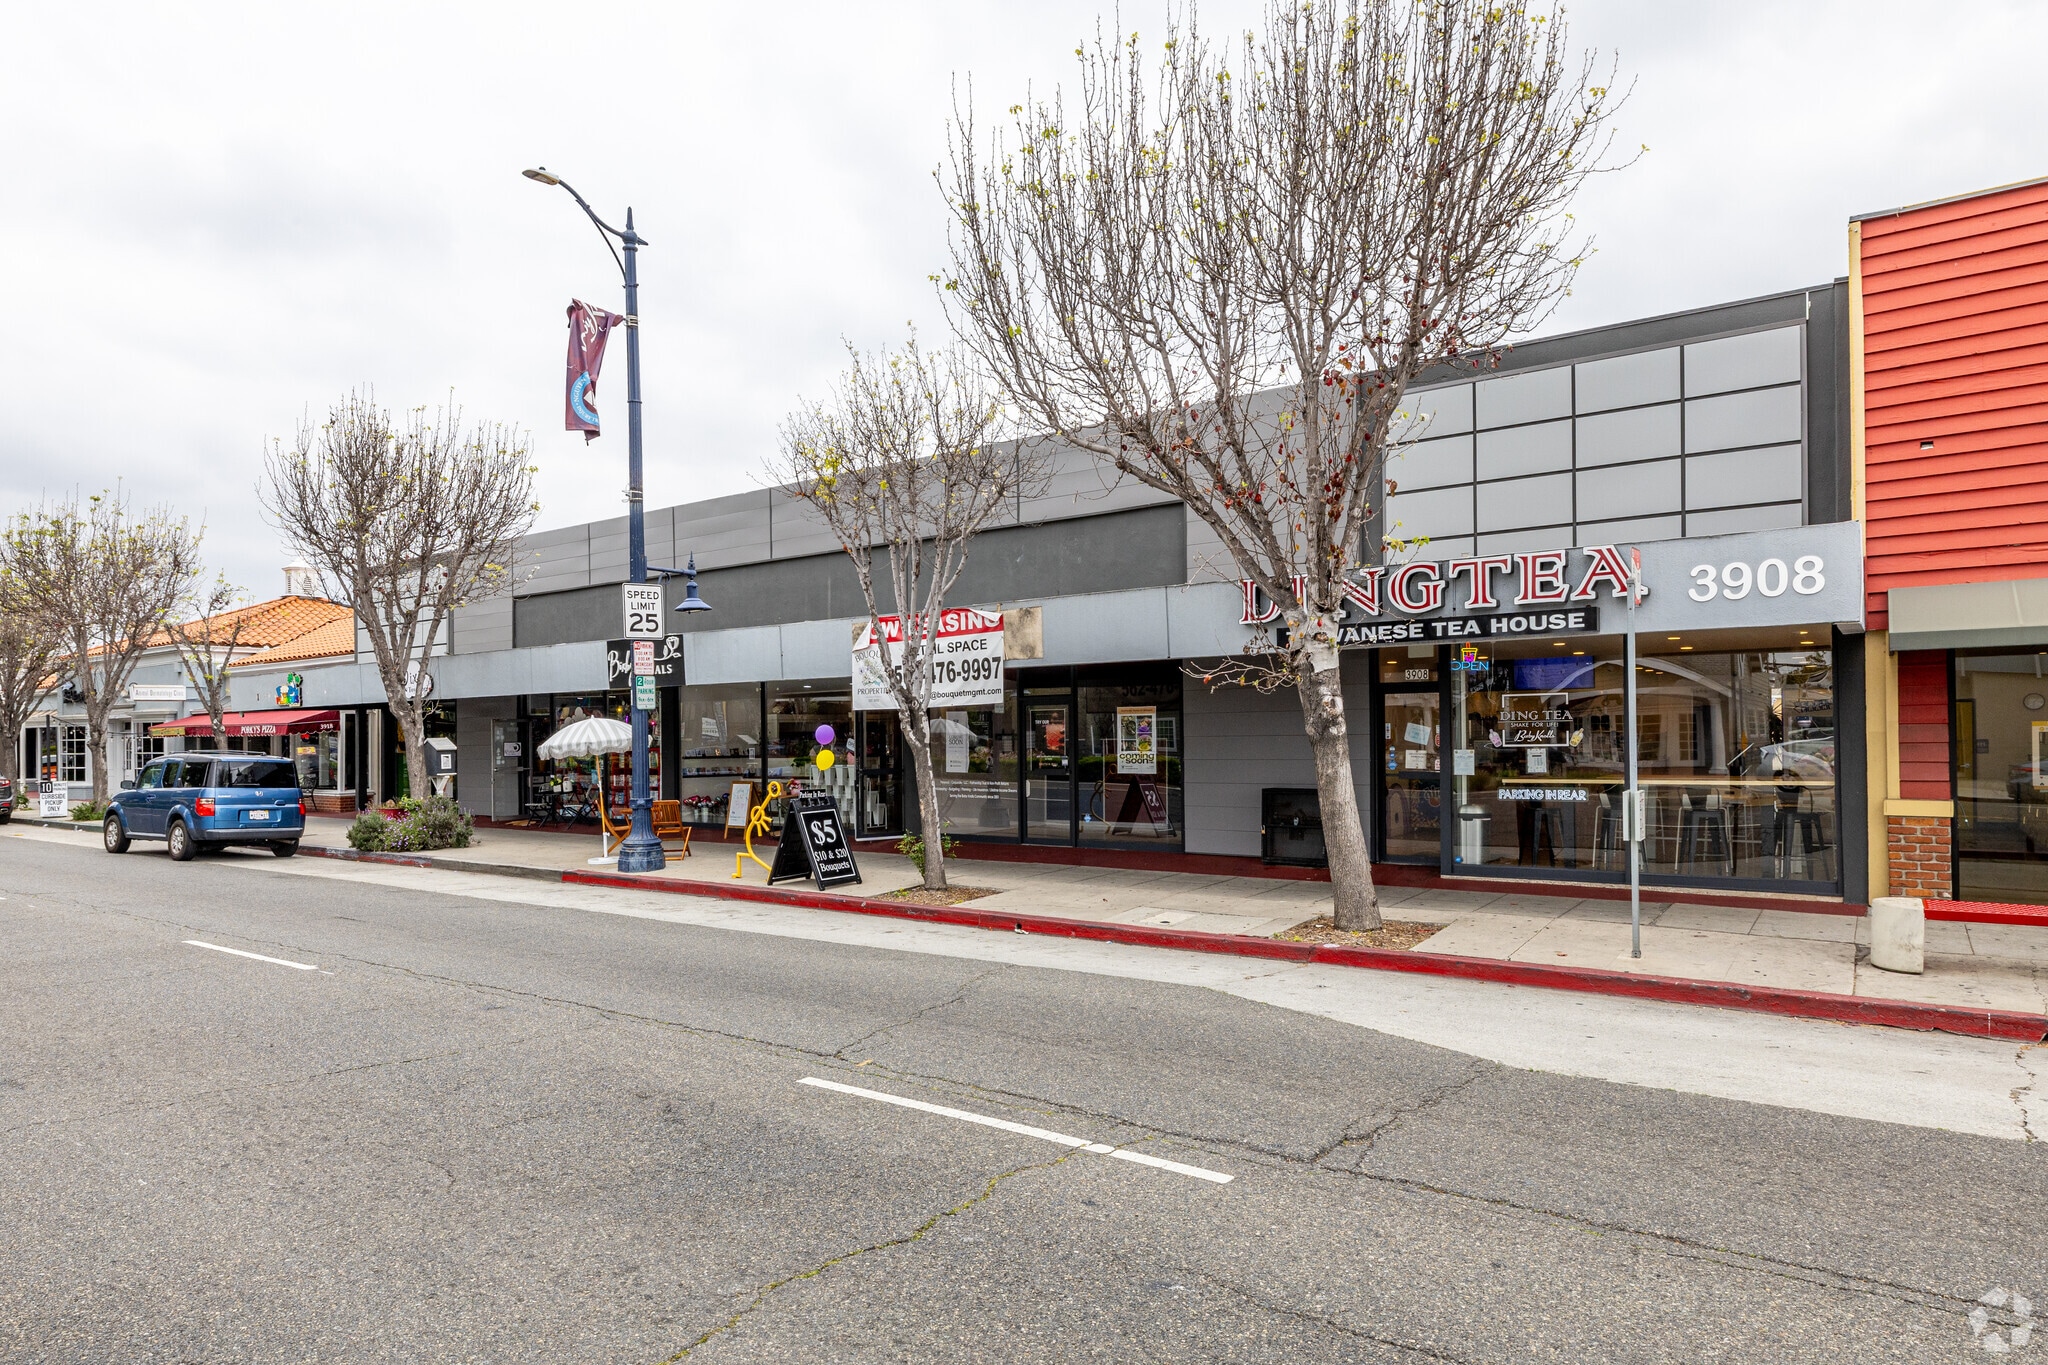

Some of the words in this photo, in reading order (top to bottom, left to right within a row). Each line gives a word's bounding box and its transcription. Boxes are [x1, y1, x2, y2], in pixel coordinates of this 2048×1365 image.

[1688, 555, 1826, 602] 3908
[627, 590, 660, 600] SPEED
[630, 602, 656, 610] LIMIT
[629, 612, 659, 633] 25
[1432, 619, 1481, 637] TEA
[1490, 612, 1585, 633] HOUSE
[946, 638, 988, 653] SPACE
[1451, 661, 1489, 671] OPEN
[1405, 669, 1428, 680] 3908
[638, 677, 643, 685] 2
[1500, 710, 1539, 721] DING
[1542, 709, 1573, 720] TEA
[261, 725, 276, 734] PIZZA
[1119, 751, 1155, 762] coming
[1125, 757, 1149, 765] soon
[41, 782, 52, 793] 10
[1498, 788, 1545, 800] PARKING
[1545, 789, 1557, 800] IN
[1557, 789, 1587, 800] REAR
[811, 819, 837, 846] $5
[814, 850, 827, 862] $10
[828, 850, 835, 859] &
[835, 848, 847, 859] $20
[819, 861, 850, 873] Bouquets
